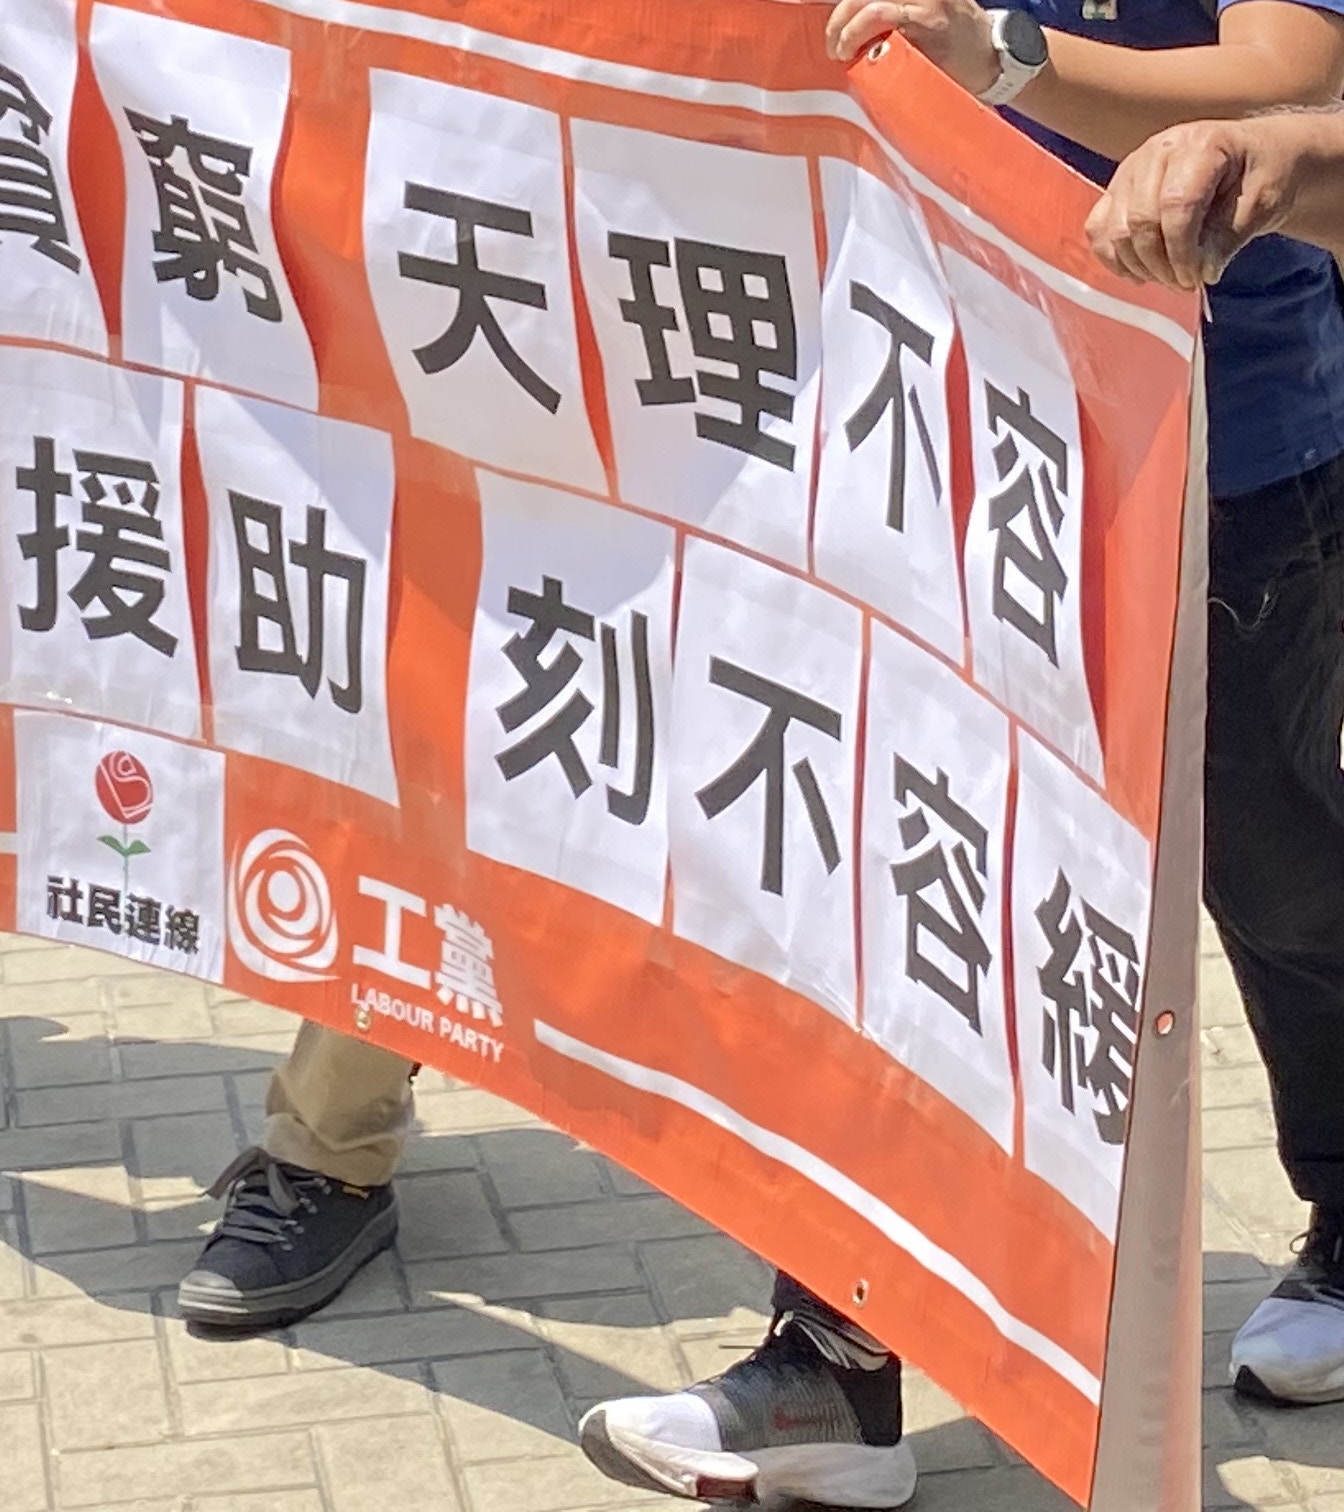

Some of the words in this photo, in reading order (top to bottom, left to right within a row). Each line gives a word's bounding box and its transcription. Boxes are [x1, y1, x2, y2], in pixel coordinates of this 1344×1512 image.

[397, 180, 1070, 669] 天理不容
[46, 875, 201, 955] 社民連線
[493, 574, 1144, 1149] 刻不容緩
[350, 982, 435, 1034] LABOUR
[439, 1017, 505, 1065] PARTY
[352, 875, 505, 1029] 工黨
